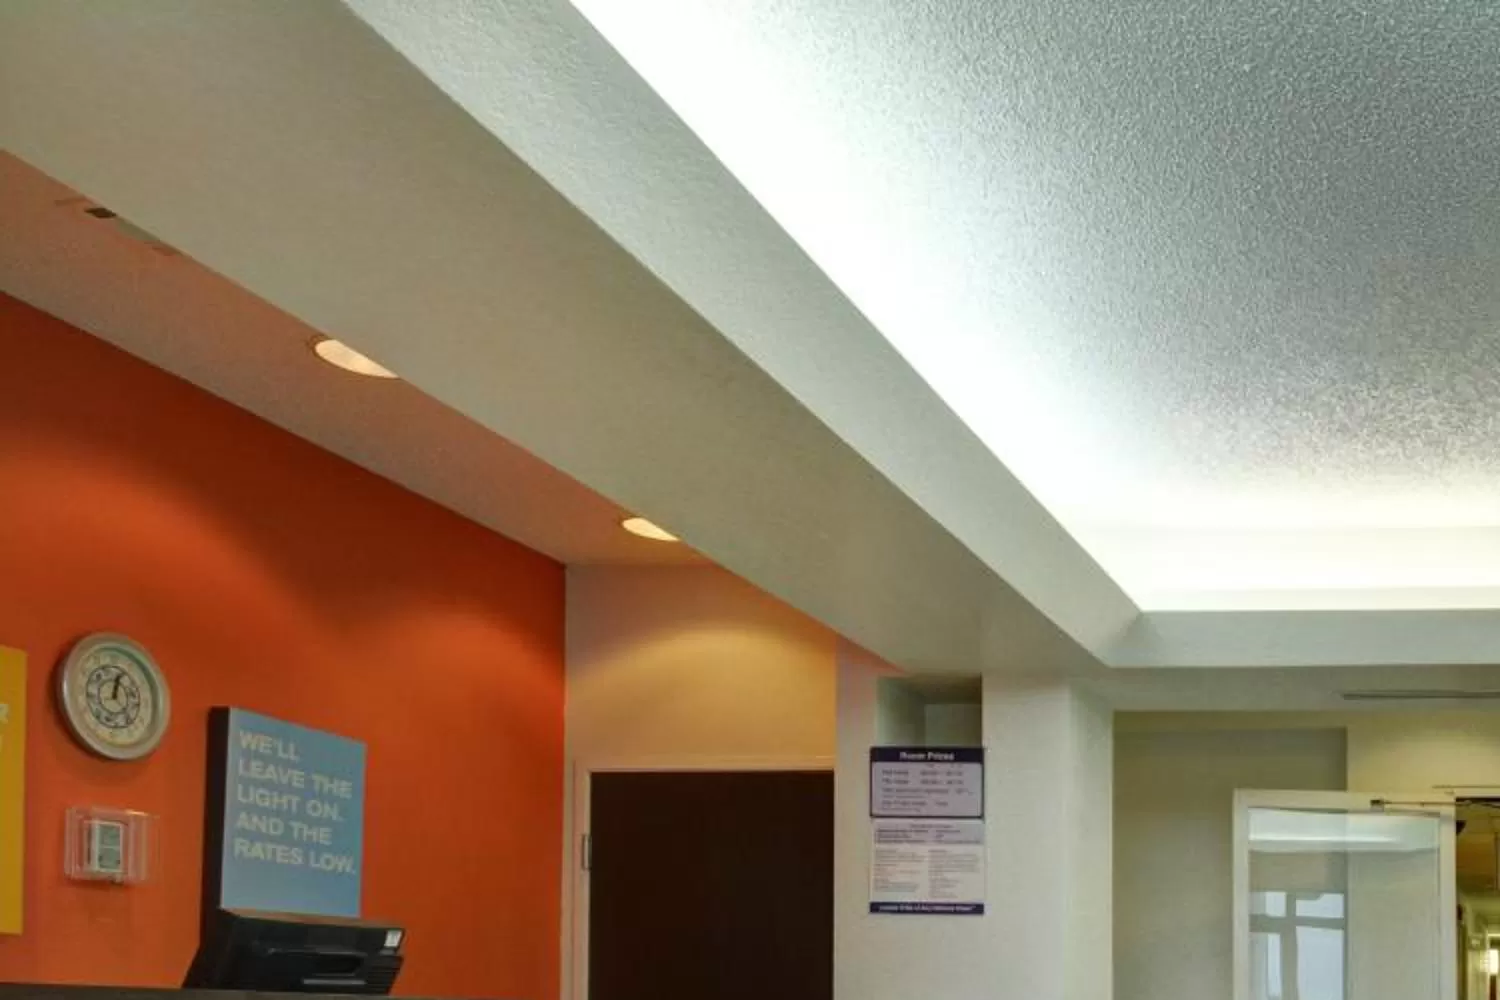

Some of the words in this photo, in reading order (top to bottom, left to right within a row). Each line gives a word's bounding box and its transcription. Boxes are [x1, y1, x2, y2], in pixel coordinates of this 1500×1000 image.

[239, 730, 299, 762] WE'LL
[238, 758, 305, 788] LEAVE
[312, 773, 353, 799] THE
[237, 784, 300, 814] LIGHT
[235, 811, 285, 836] AND
[288, 820, 333, 846] THE
[233, 837, 304, 865] RATES
